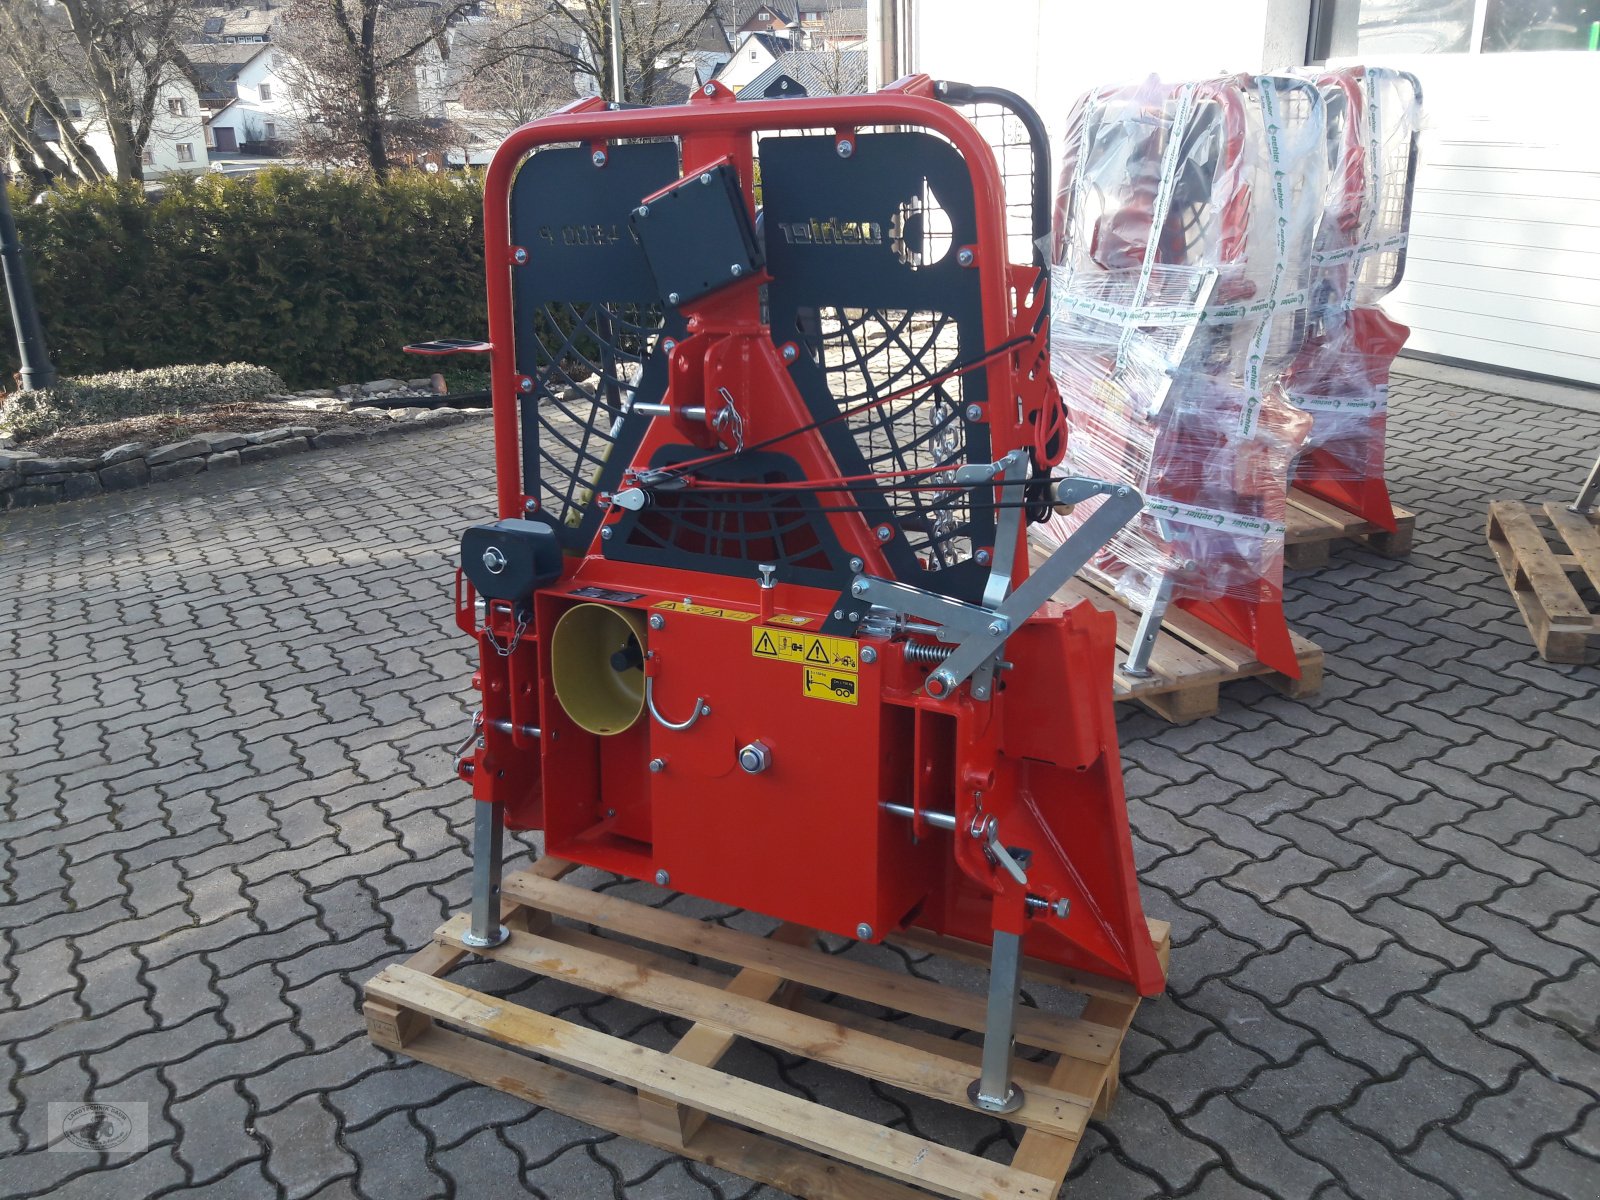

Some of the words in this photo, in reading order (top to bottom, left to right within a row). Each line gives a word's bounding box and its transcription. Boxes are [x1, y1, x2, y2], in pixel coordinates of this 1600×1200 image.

[1271, 135, 1279, 163] oehler
[1243, 408, 1253, 436] oehler
[1185, 510, 1213, 520] oehler
[1232, 520, 1260, 529] oehler
